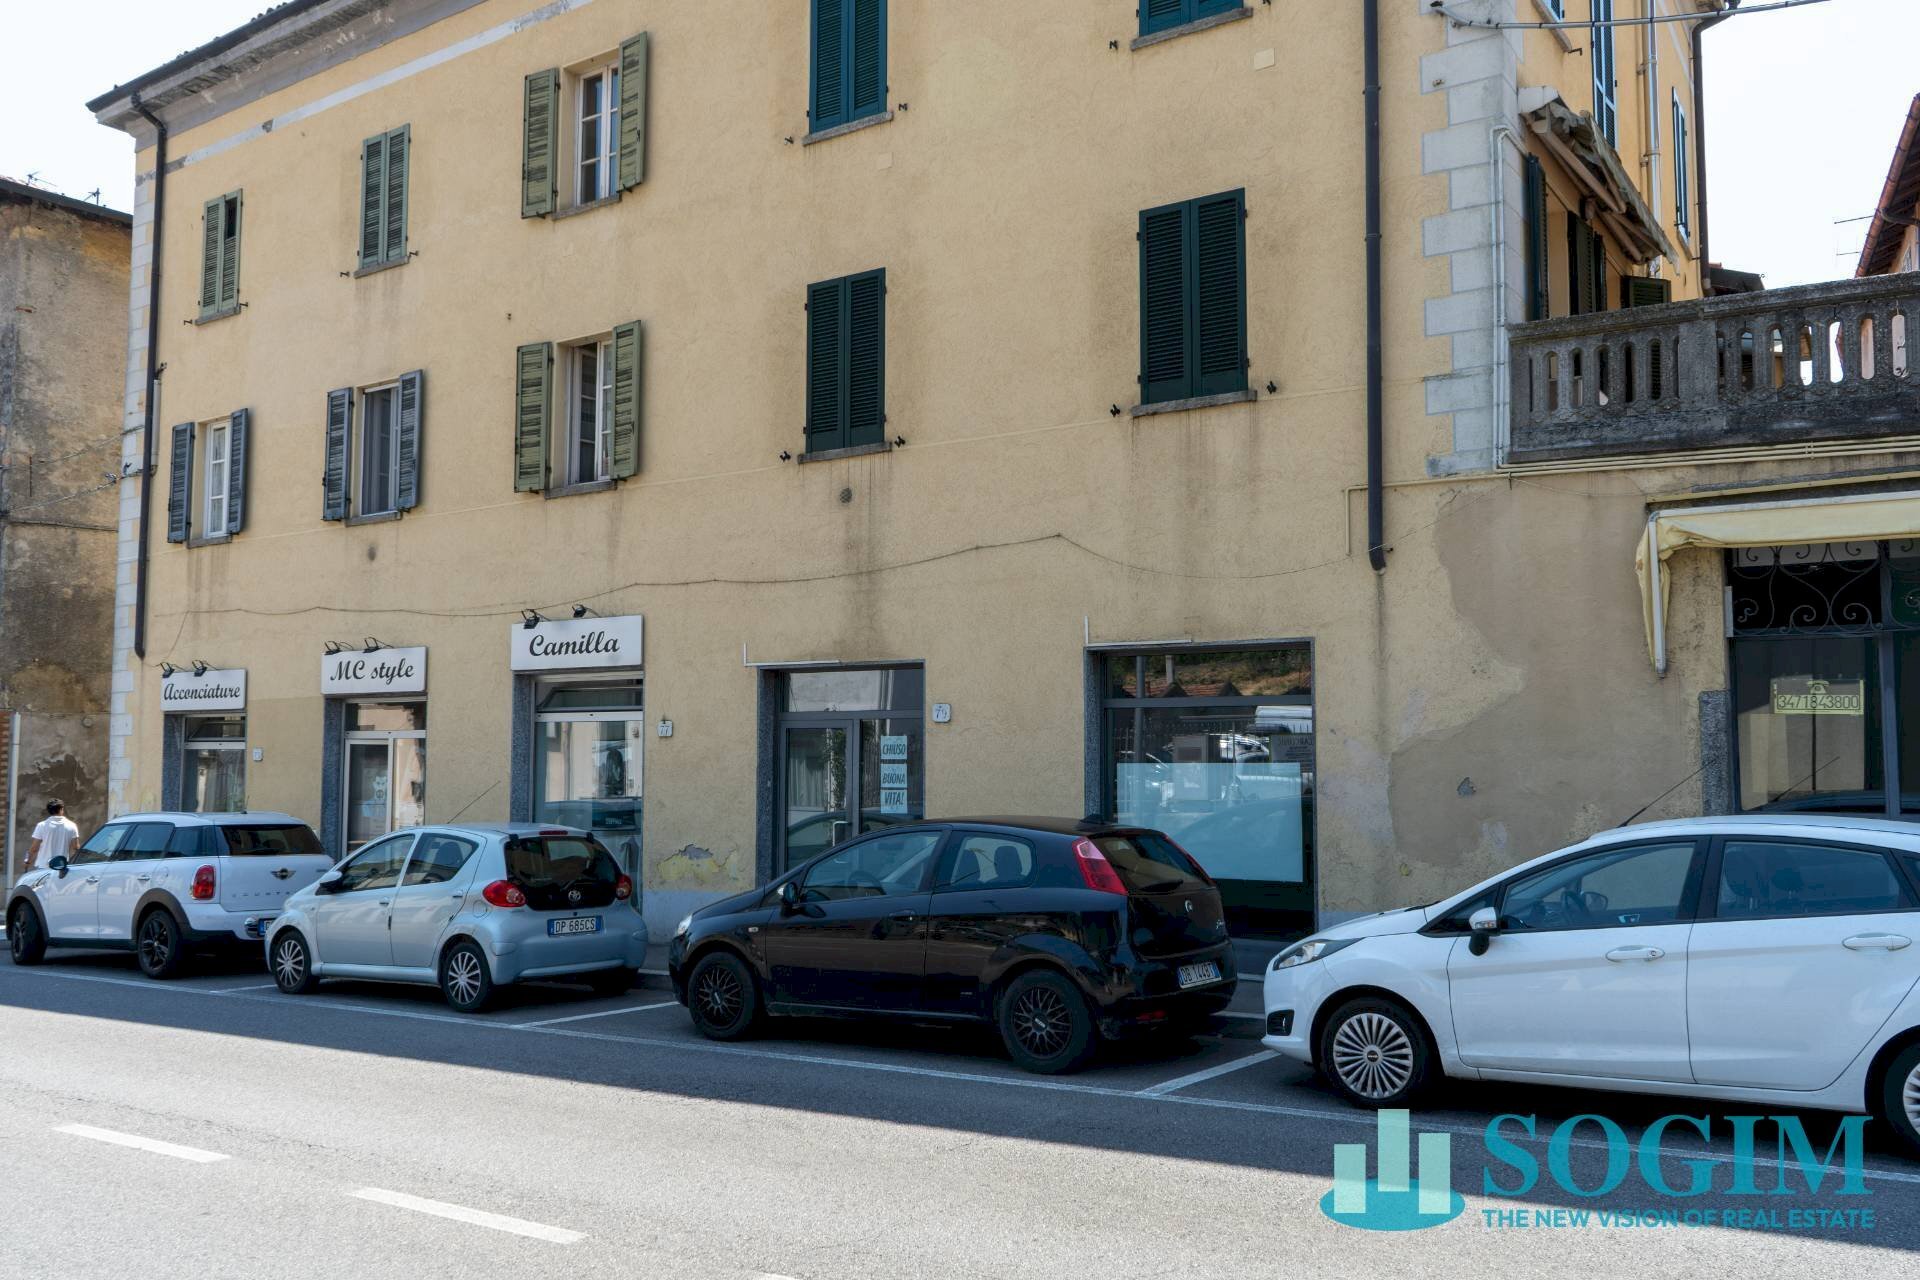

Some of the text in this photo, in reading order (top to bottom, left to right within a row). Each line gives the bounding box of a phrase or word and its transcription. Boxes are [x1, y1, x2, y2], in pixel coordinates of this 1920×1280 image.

[529, 630, 621, 657] Camilla
[329, 657, 415, 686] MC style
[163, 682, 241, 701] Acconciature
[882, 743, 906, 755] CHIUSO
[882, 772, 906, 785] BUONA
[884, 791, 905, 806] VITA!
